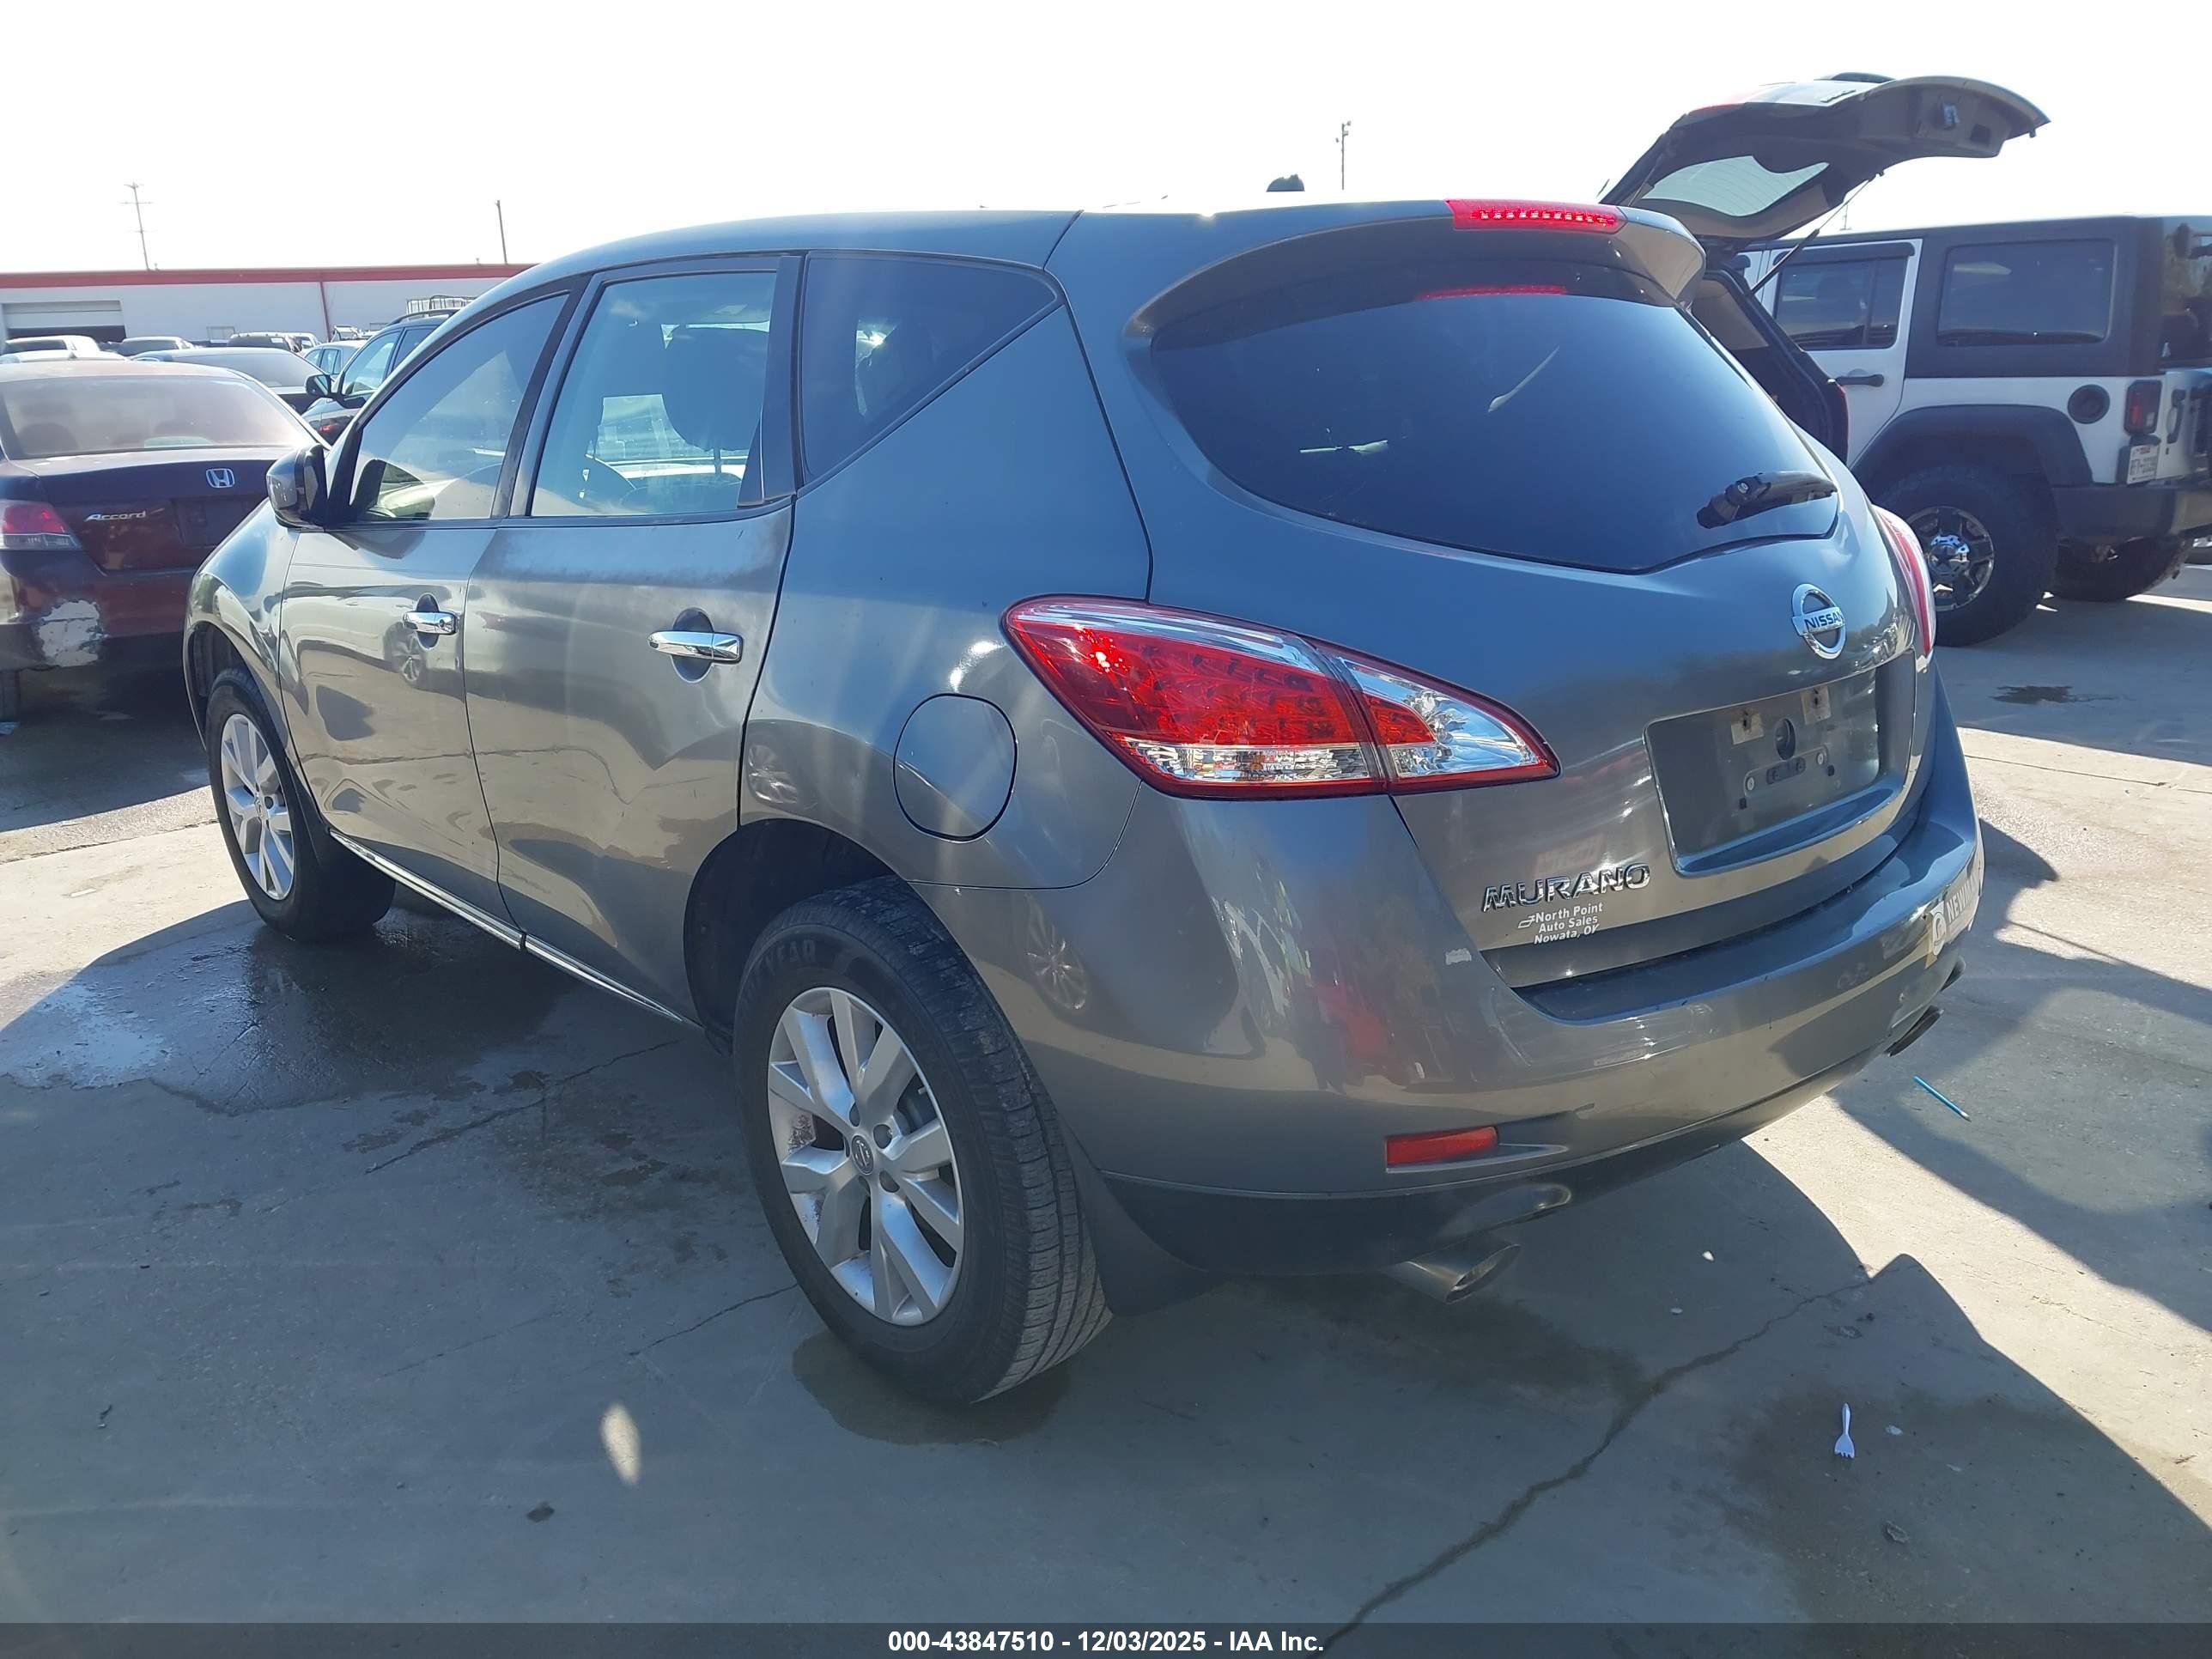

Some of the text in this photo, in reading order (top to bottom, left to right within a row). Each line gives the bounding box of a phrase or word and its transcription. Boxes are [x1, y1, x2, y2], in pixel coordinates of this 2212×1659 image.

[83, 510, 146, 522] Accord
[1483, 863, 1650, 913] MURANO
[1534, 902, 1603, 923] North Point
[1539, 915, 1598, 933] Auto Sales
[1534, 928, 1581, 945] Nowata,
